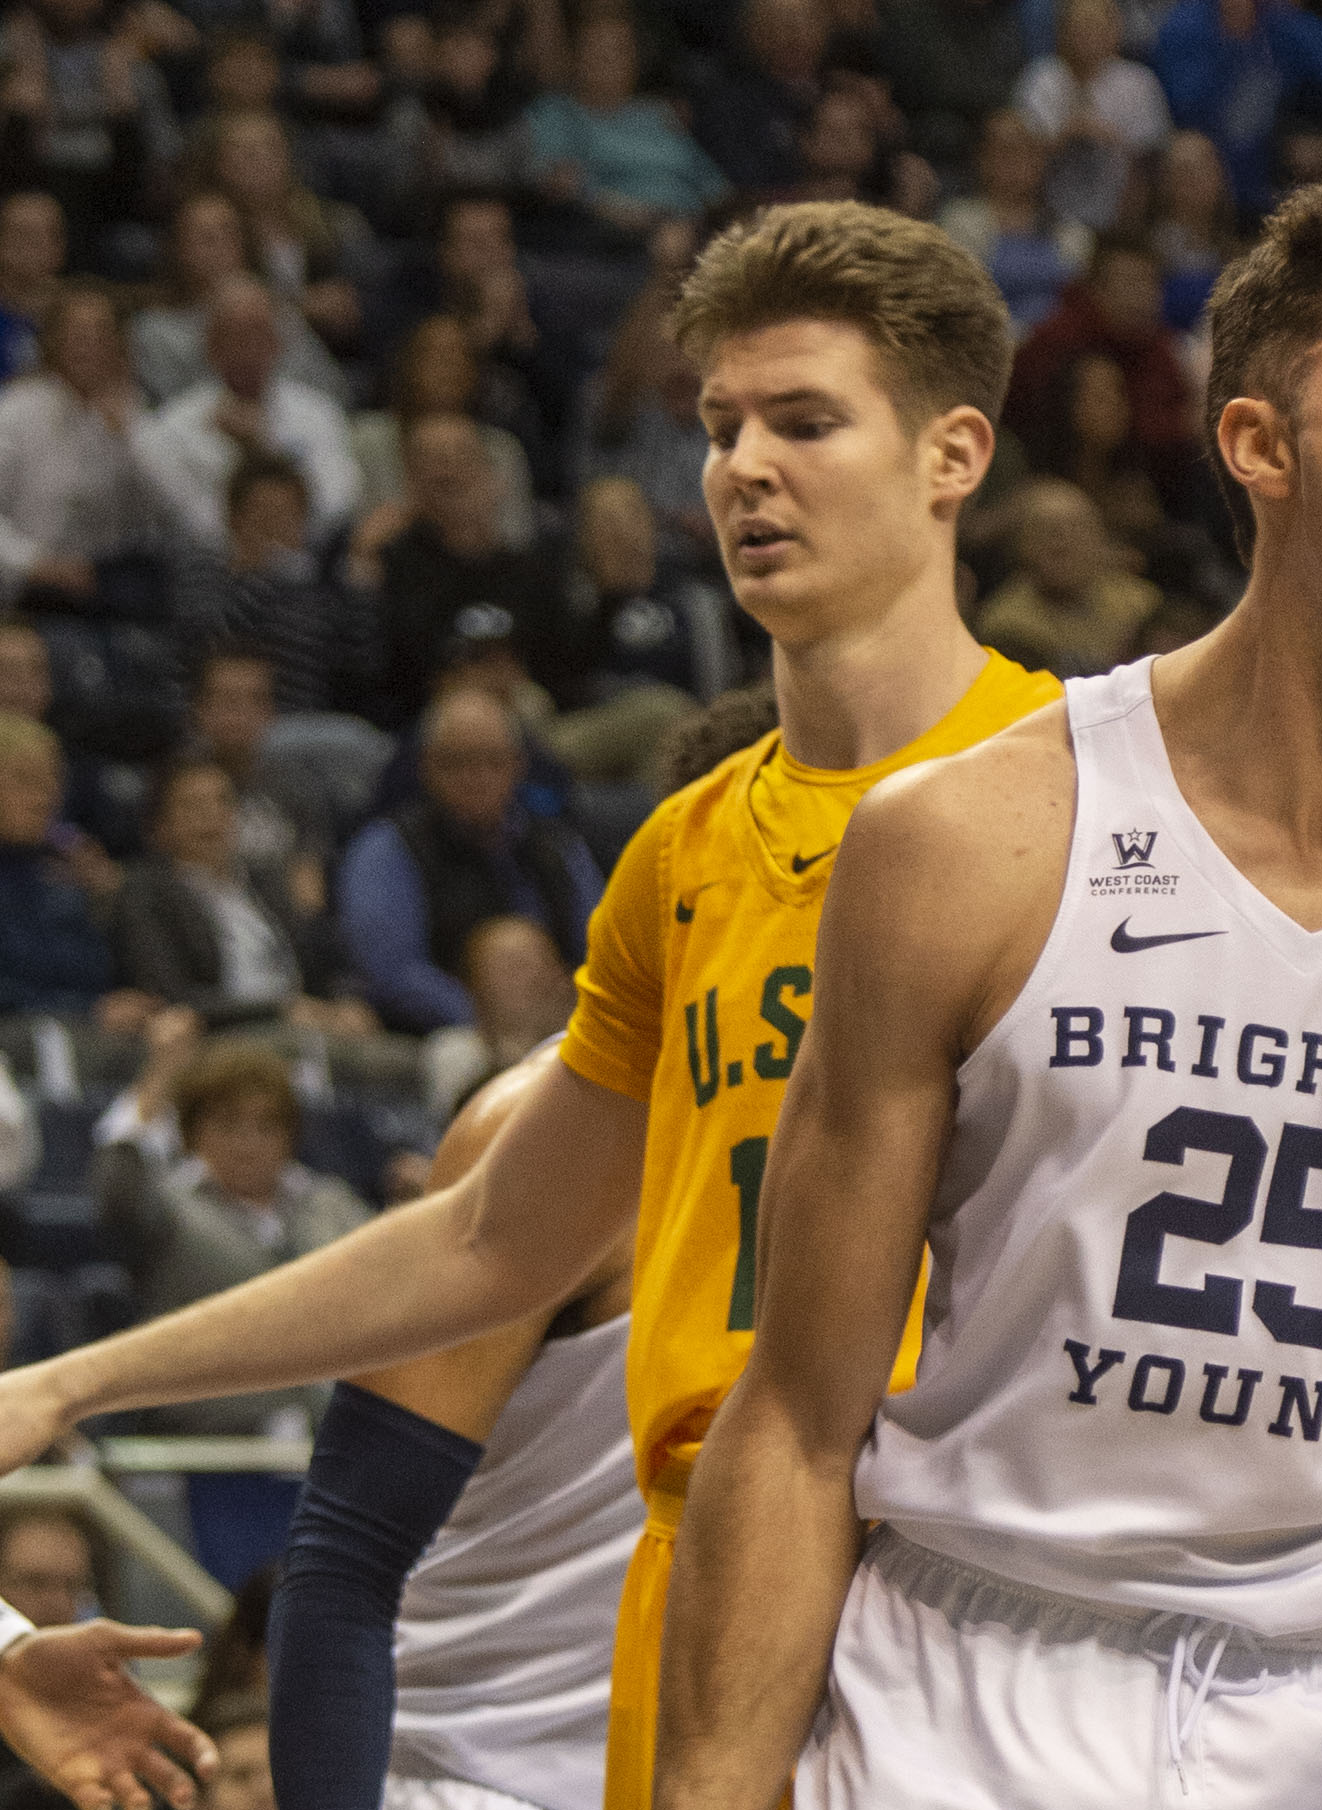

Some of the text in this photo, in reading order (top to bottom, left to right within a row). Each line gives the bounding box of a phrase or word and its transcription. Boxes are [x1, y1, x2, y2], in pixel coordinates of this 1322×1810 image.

[1089, 874, 1180, 887] WEST COAST
[1091, 886, 1176, 896] CONFERENCE
